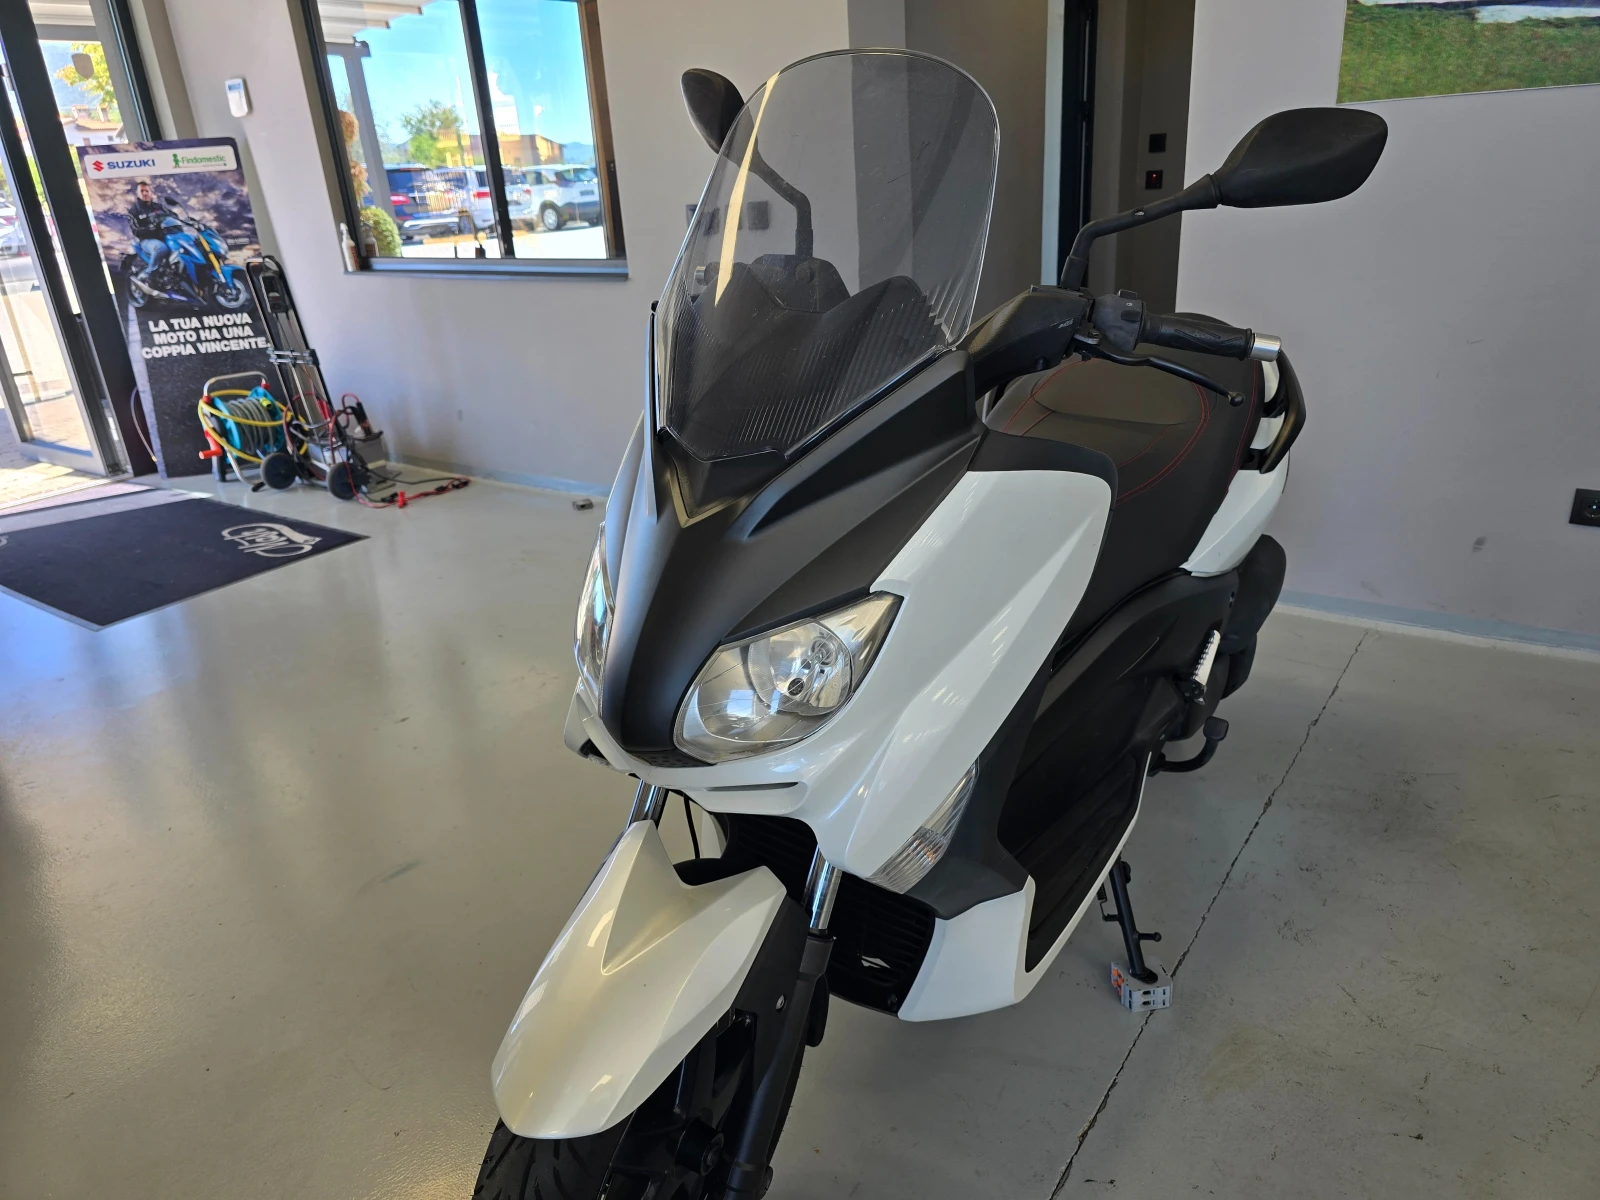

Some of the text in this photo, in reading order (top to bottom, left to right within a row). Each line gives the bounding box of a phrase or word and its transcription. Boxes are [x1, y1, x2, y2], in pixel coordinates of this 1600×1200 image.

[107, 159, 156, 169] SUZUKI
[181, 155, 226, 164] Findomestic
[149, 312, 252, 332] LA TUA NUOVA
[153, 325, 254, 344] MOTO HA UNA
[141, 344, 196, 359] COPPIA
